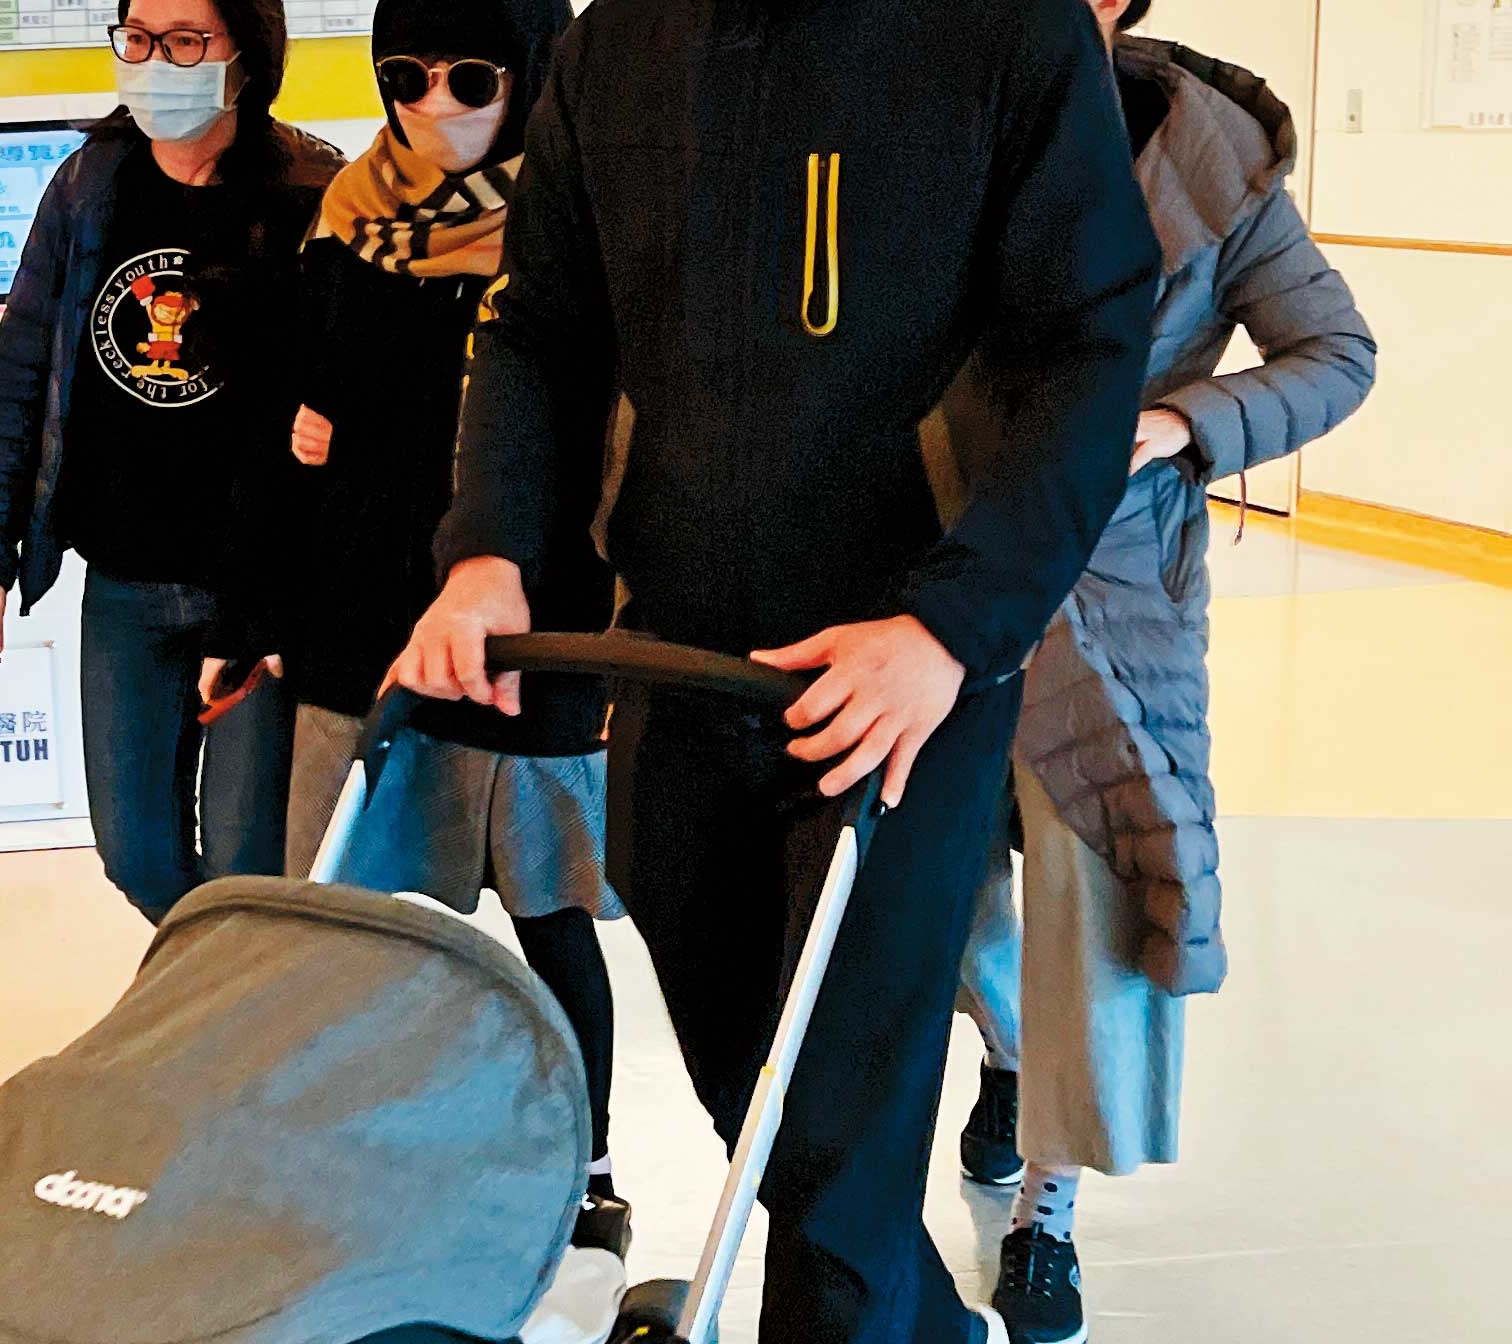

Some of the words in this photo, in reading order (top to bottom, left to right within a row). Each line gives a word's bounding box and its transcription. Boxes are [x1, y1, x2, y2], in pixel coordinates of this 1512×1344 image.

[114, 254, 169, 293] youth
[94, 292, 132, 379] reckless
[136, 379, 168, 400] the
[179, 377, 209, 397] for
